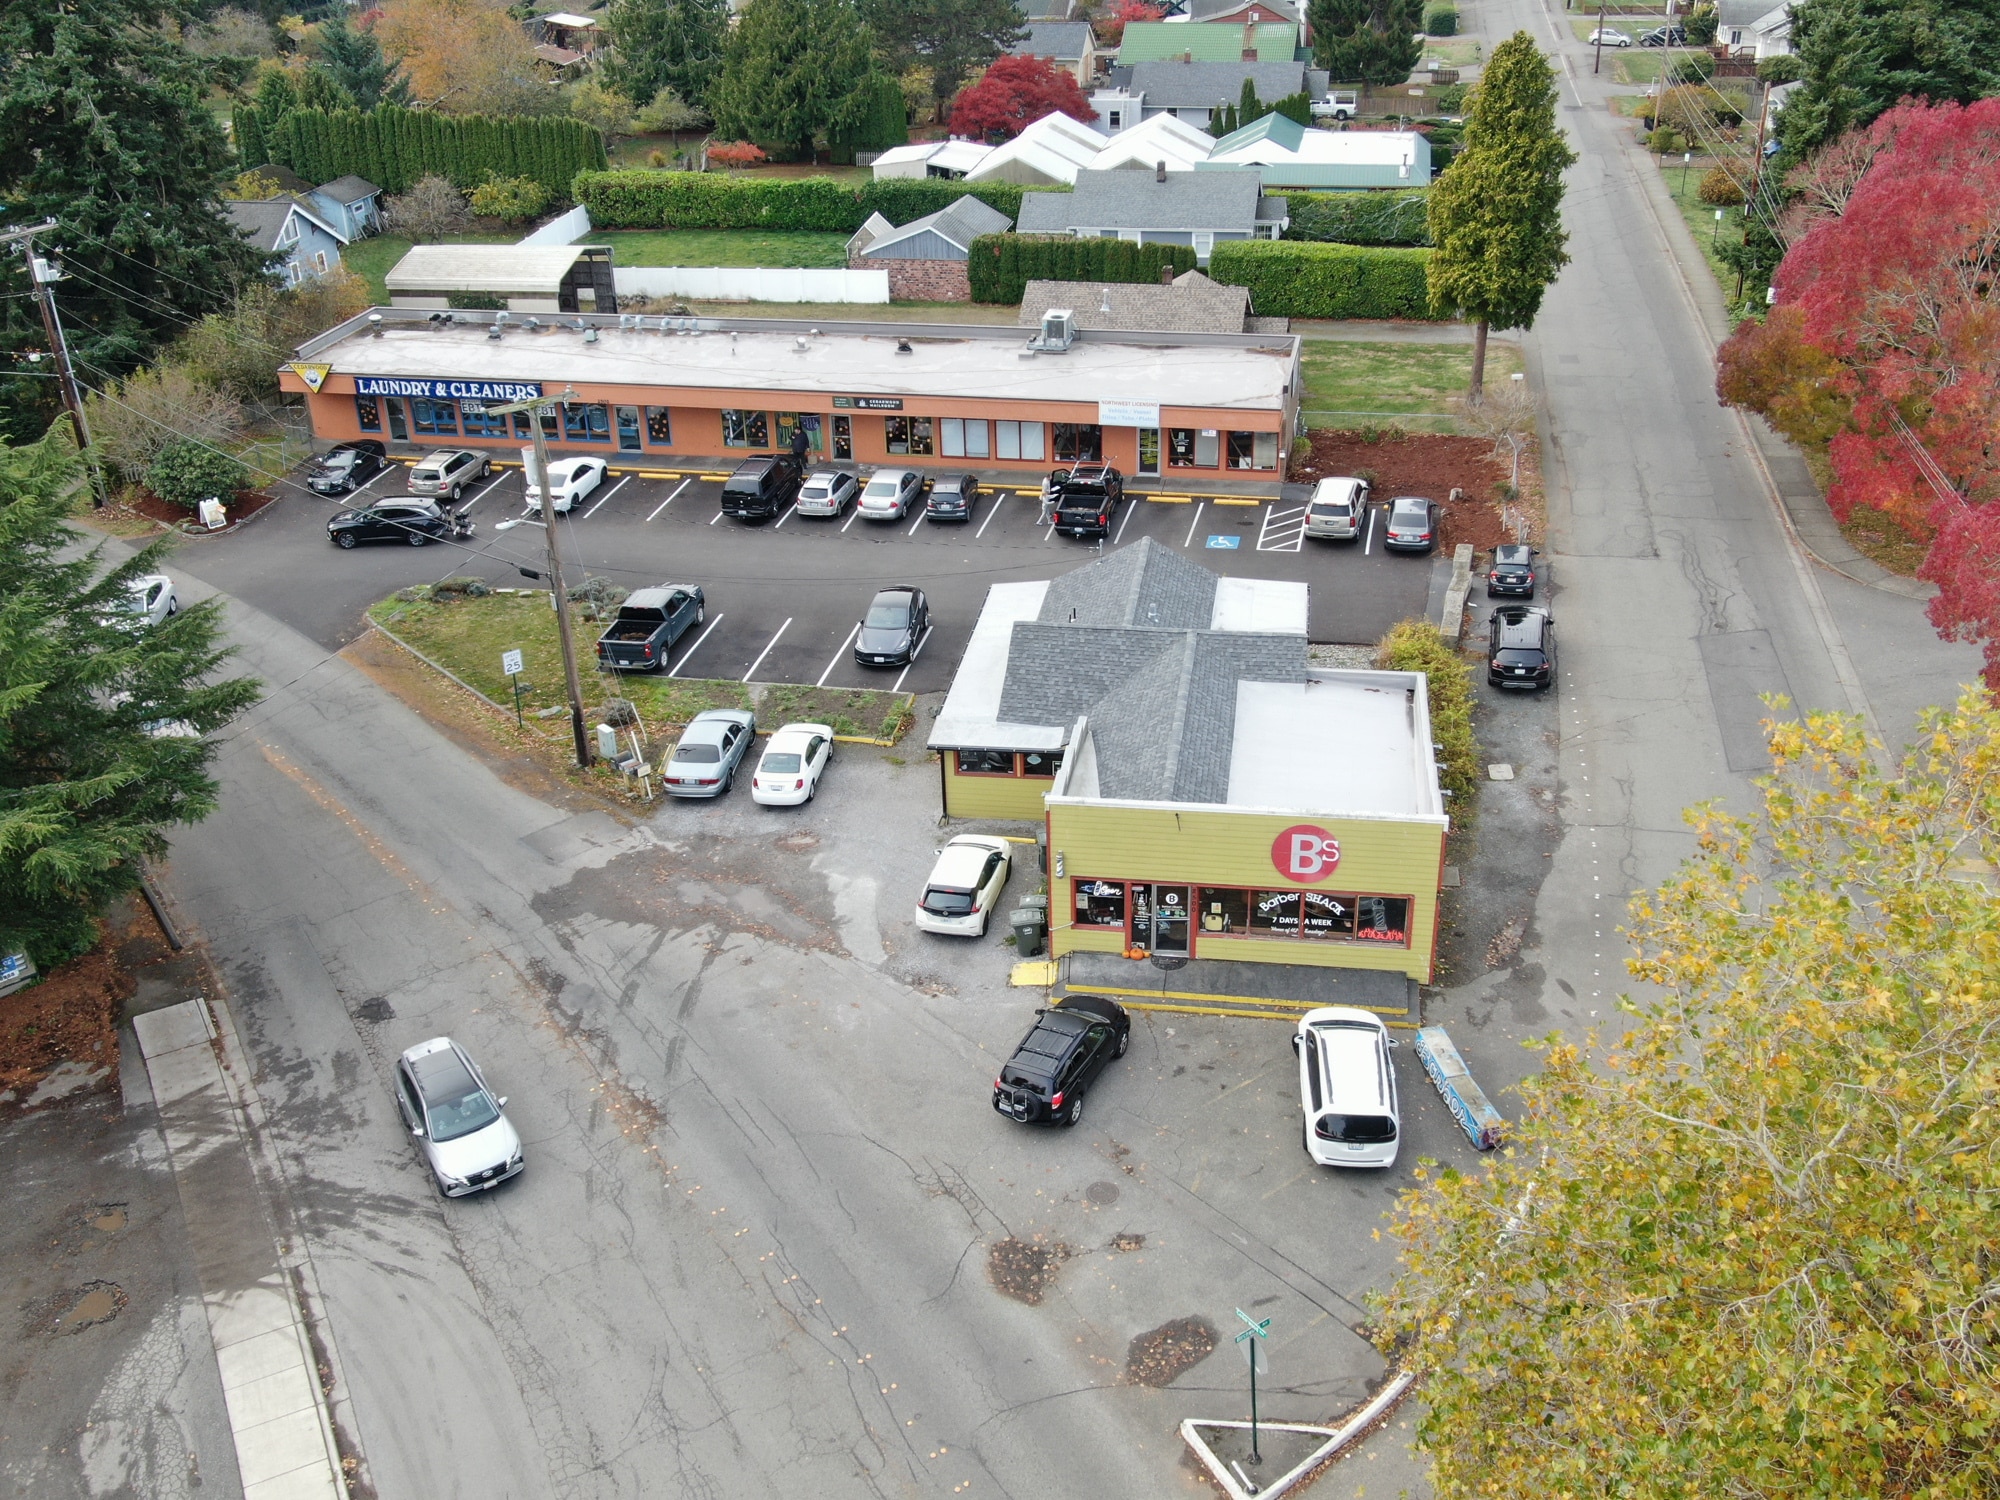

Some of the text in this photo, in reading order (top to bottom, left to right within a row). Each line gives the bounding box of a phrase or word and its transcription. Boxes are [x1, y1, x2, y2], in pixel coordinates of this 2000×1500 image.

[358, 379, 538, 400] LAUNDRY & CLEANERS
[462, 403, 480, 412] EBT
[506, 661, 520, 672] 25
[1169, 892, 1176, 902] B
[1258, 892, 1346, 916] Barber SHACK
